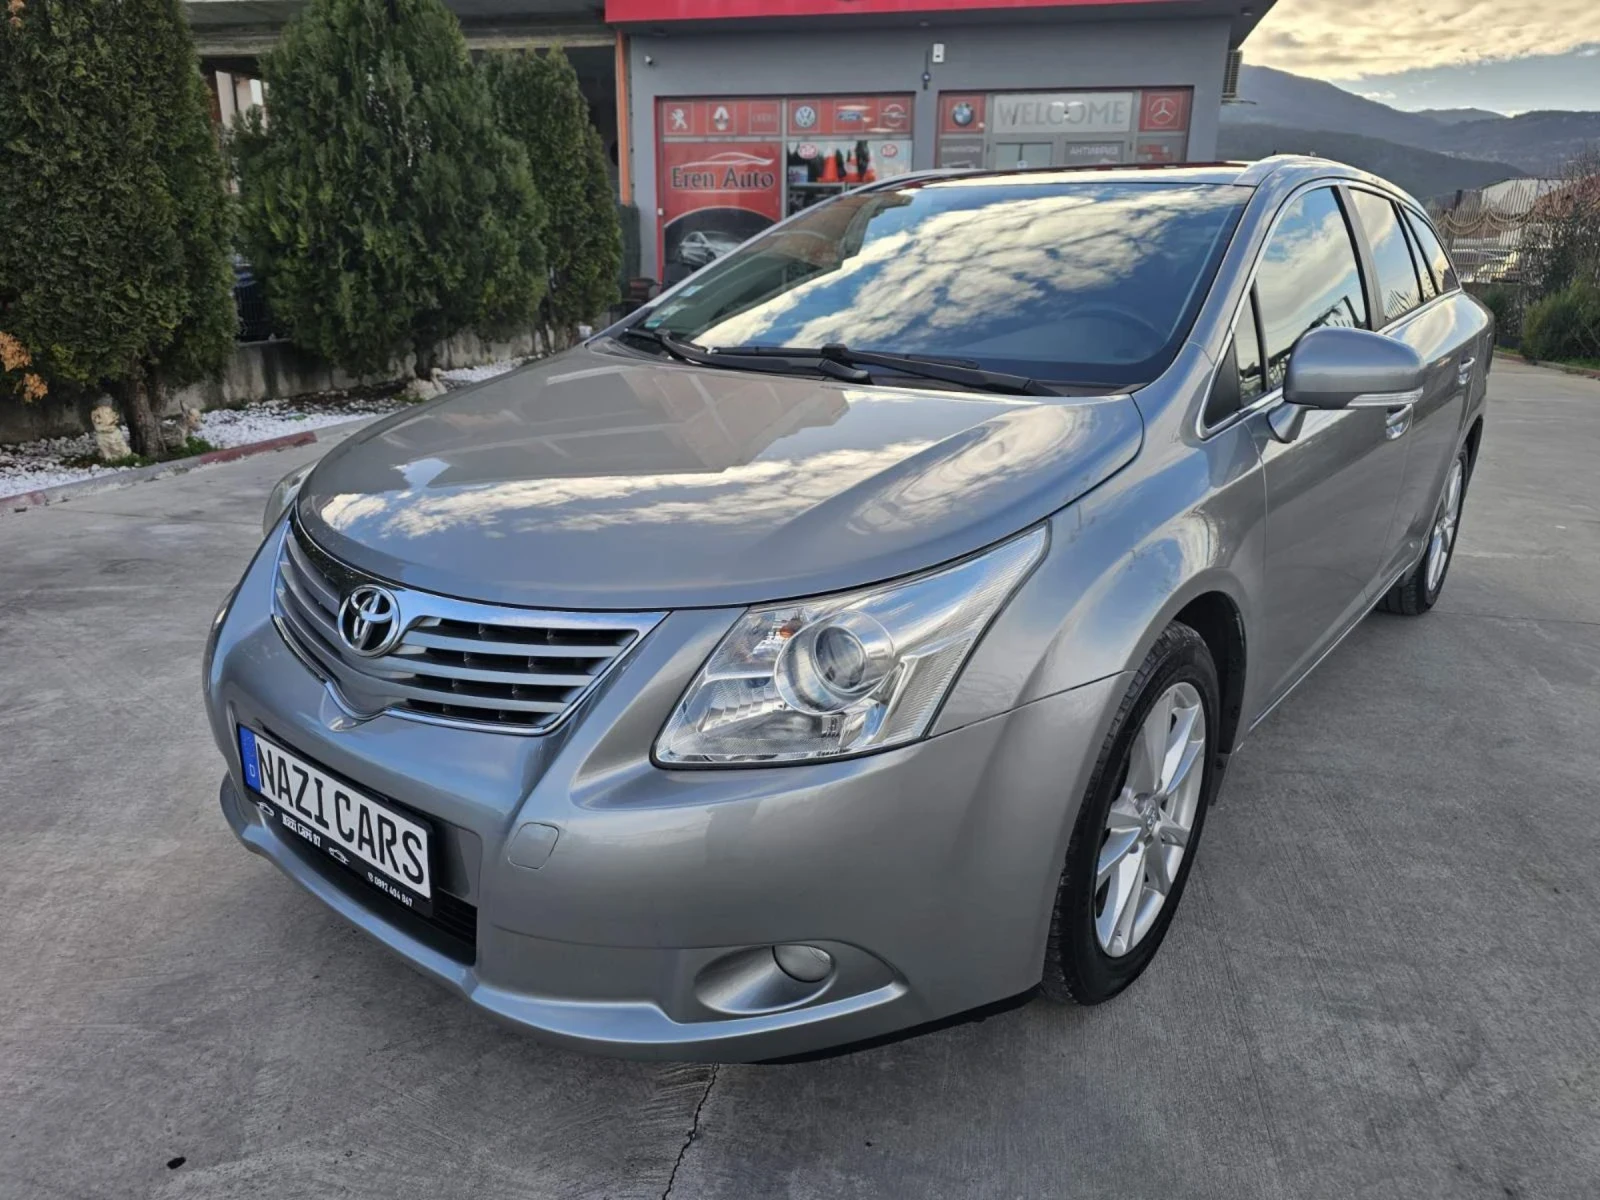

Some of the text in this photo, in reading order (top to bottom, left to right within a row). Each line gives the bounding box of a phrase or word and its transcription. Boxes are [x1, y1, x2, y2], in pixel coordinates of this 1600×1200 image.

[1000, 100, 1125, 127] WELCOME
[671, 167, 774, 189] Eren Auto
[256, 742, 424, 885] NAZI CARS
